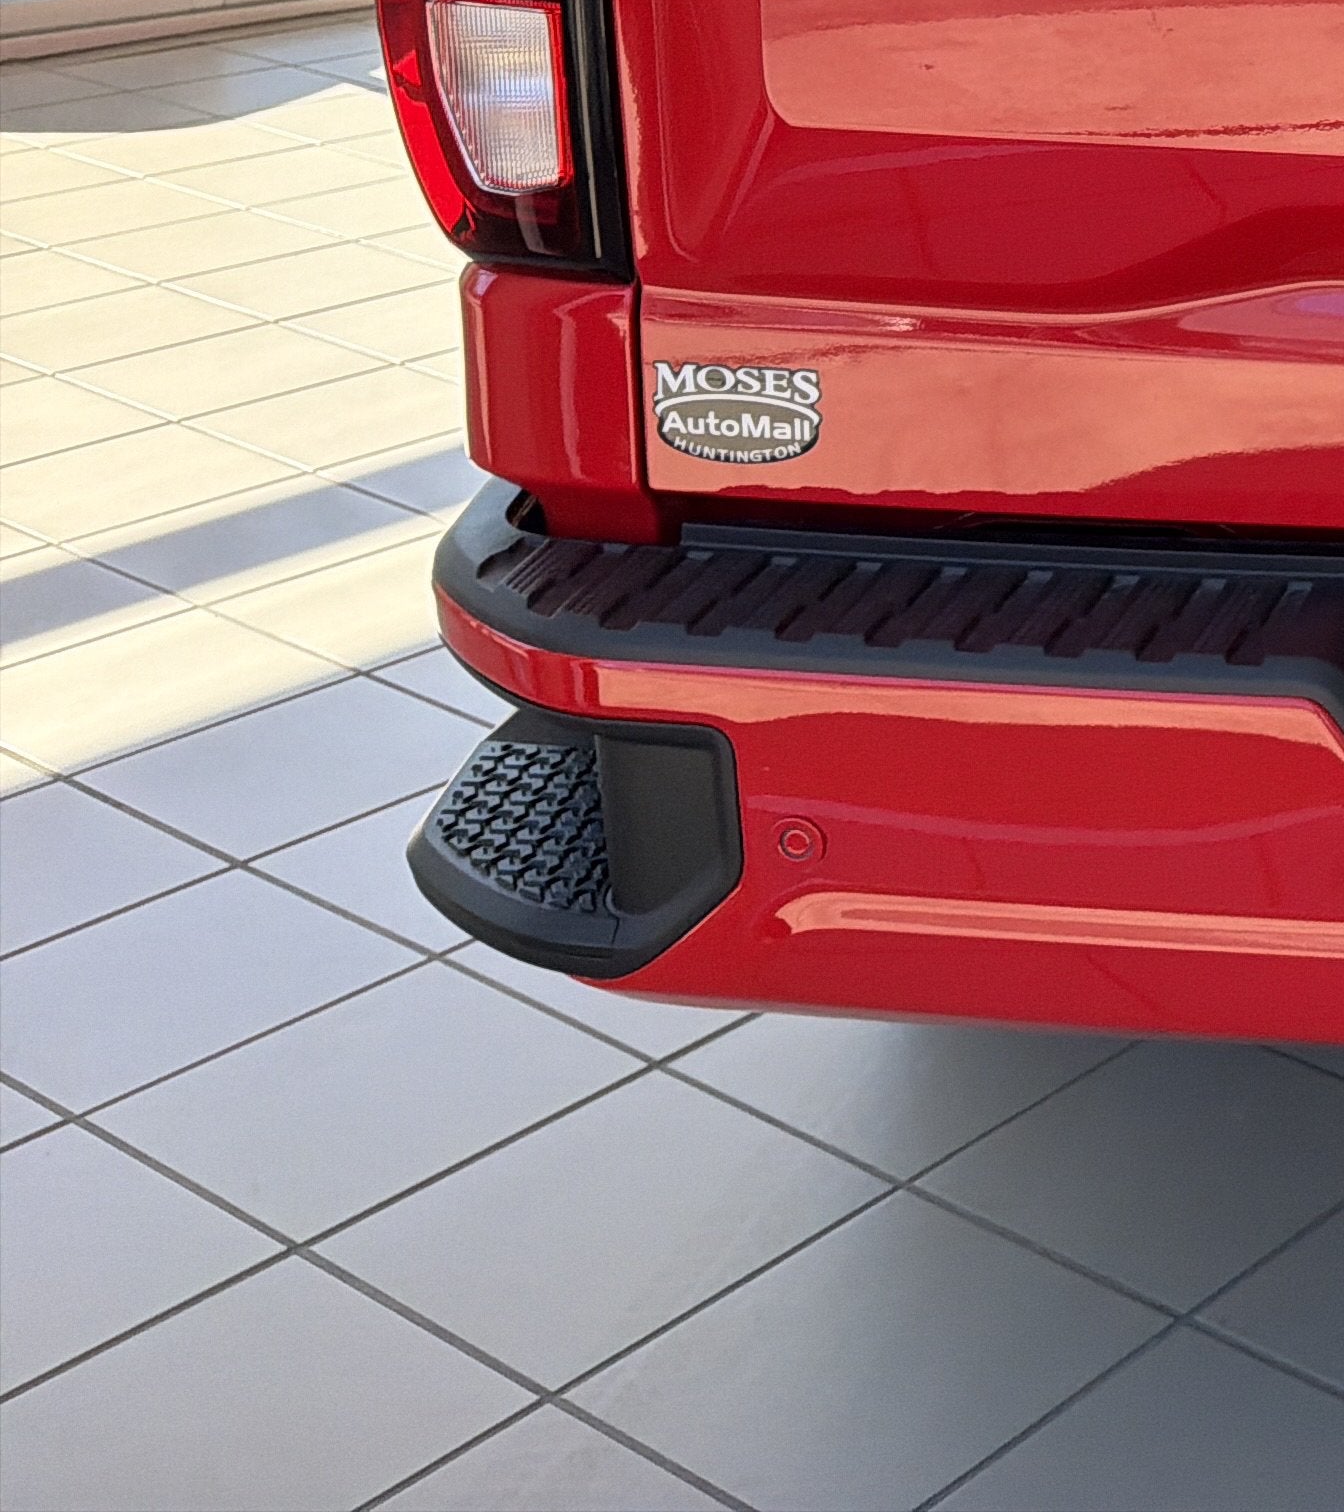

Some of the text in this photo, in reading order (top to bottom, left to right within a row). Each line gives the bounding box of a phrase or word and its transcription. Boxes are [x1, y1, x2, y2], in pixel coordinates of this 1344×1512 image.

[653, 361, 821, 405] MOSES
[662, 410, 812, 442] AutoMall
[673, 436, 803, 463] HUNTINGTON
